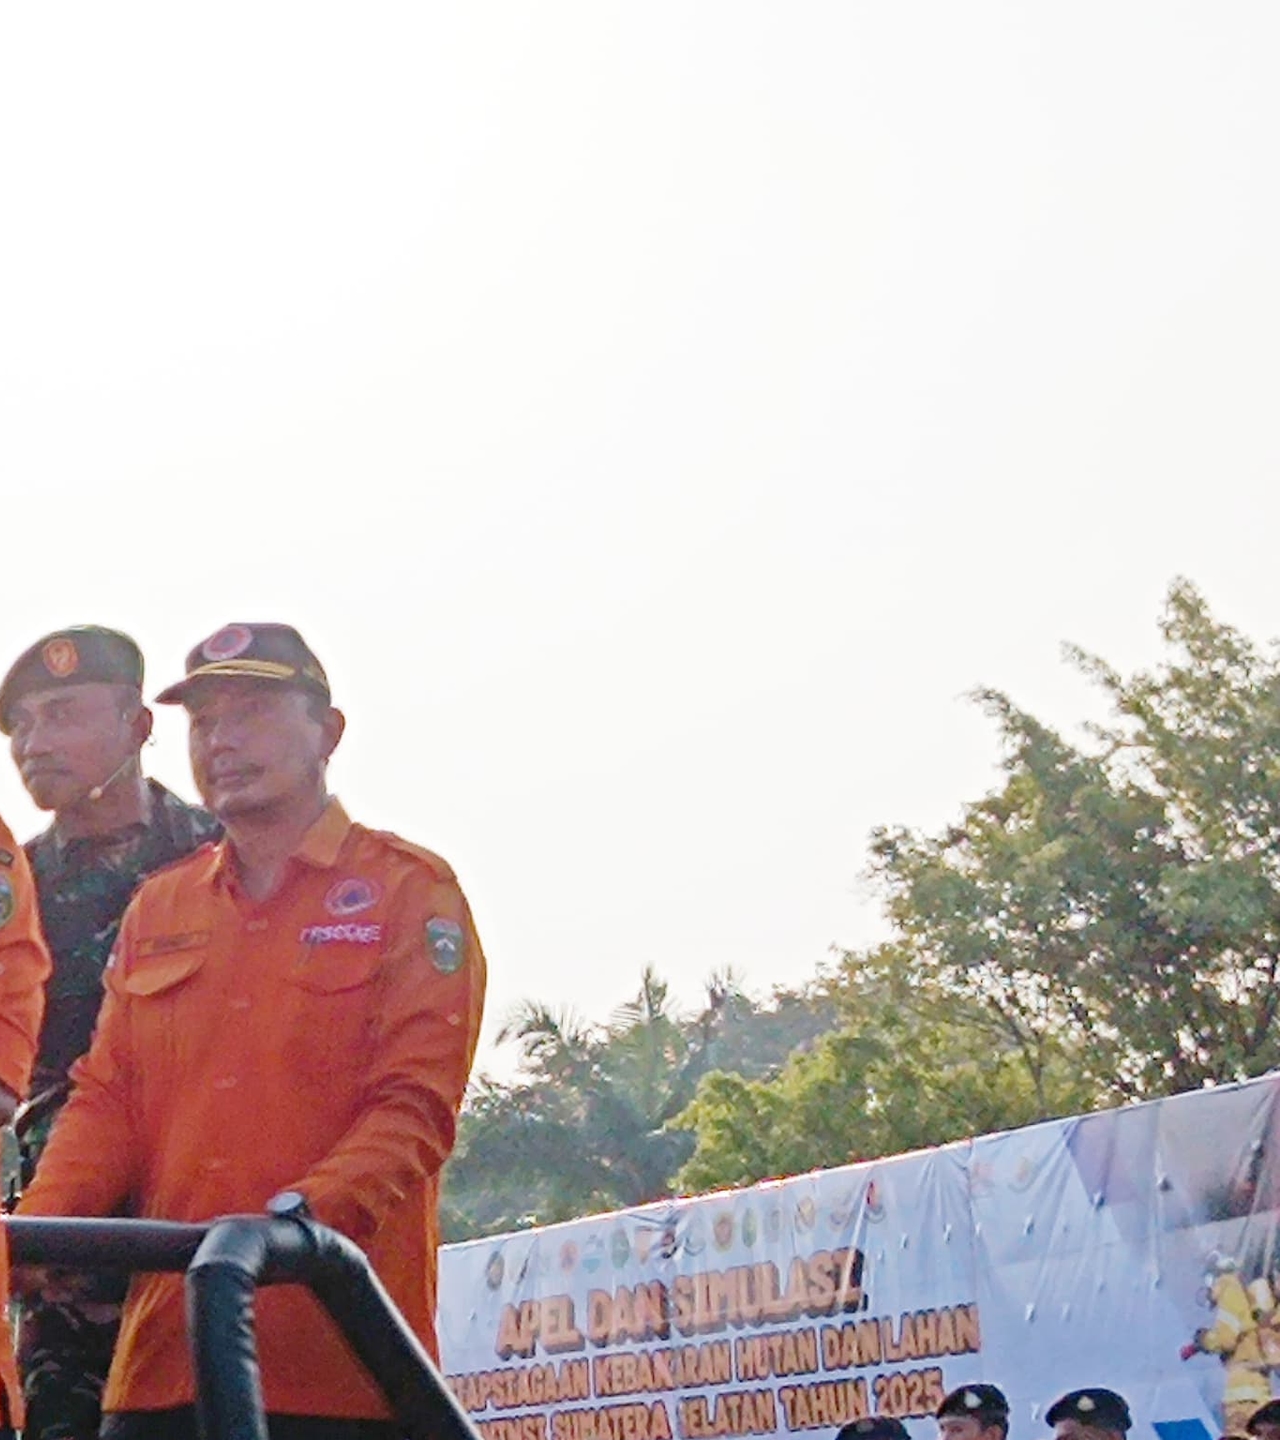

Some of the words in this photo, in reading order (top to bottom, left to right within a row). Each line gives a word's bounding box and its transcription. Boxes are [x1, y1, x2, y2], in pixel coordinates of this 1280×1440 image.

[496, 1294, 585, 1361] APEL
[587, 1279, 671, 1347] DAN
[672, 1246, 865, 1338] SIMULASI
[735, 1326, 819, 1382] HUTAN
[820, 1316, 881, 1371] DAN
[881, 1302, 978, 1363] LAHAN
[778, 1376, 868, 1432] TAHUN
[872, 1366, 944, 1420] 2025
